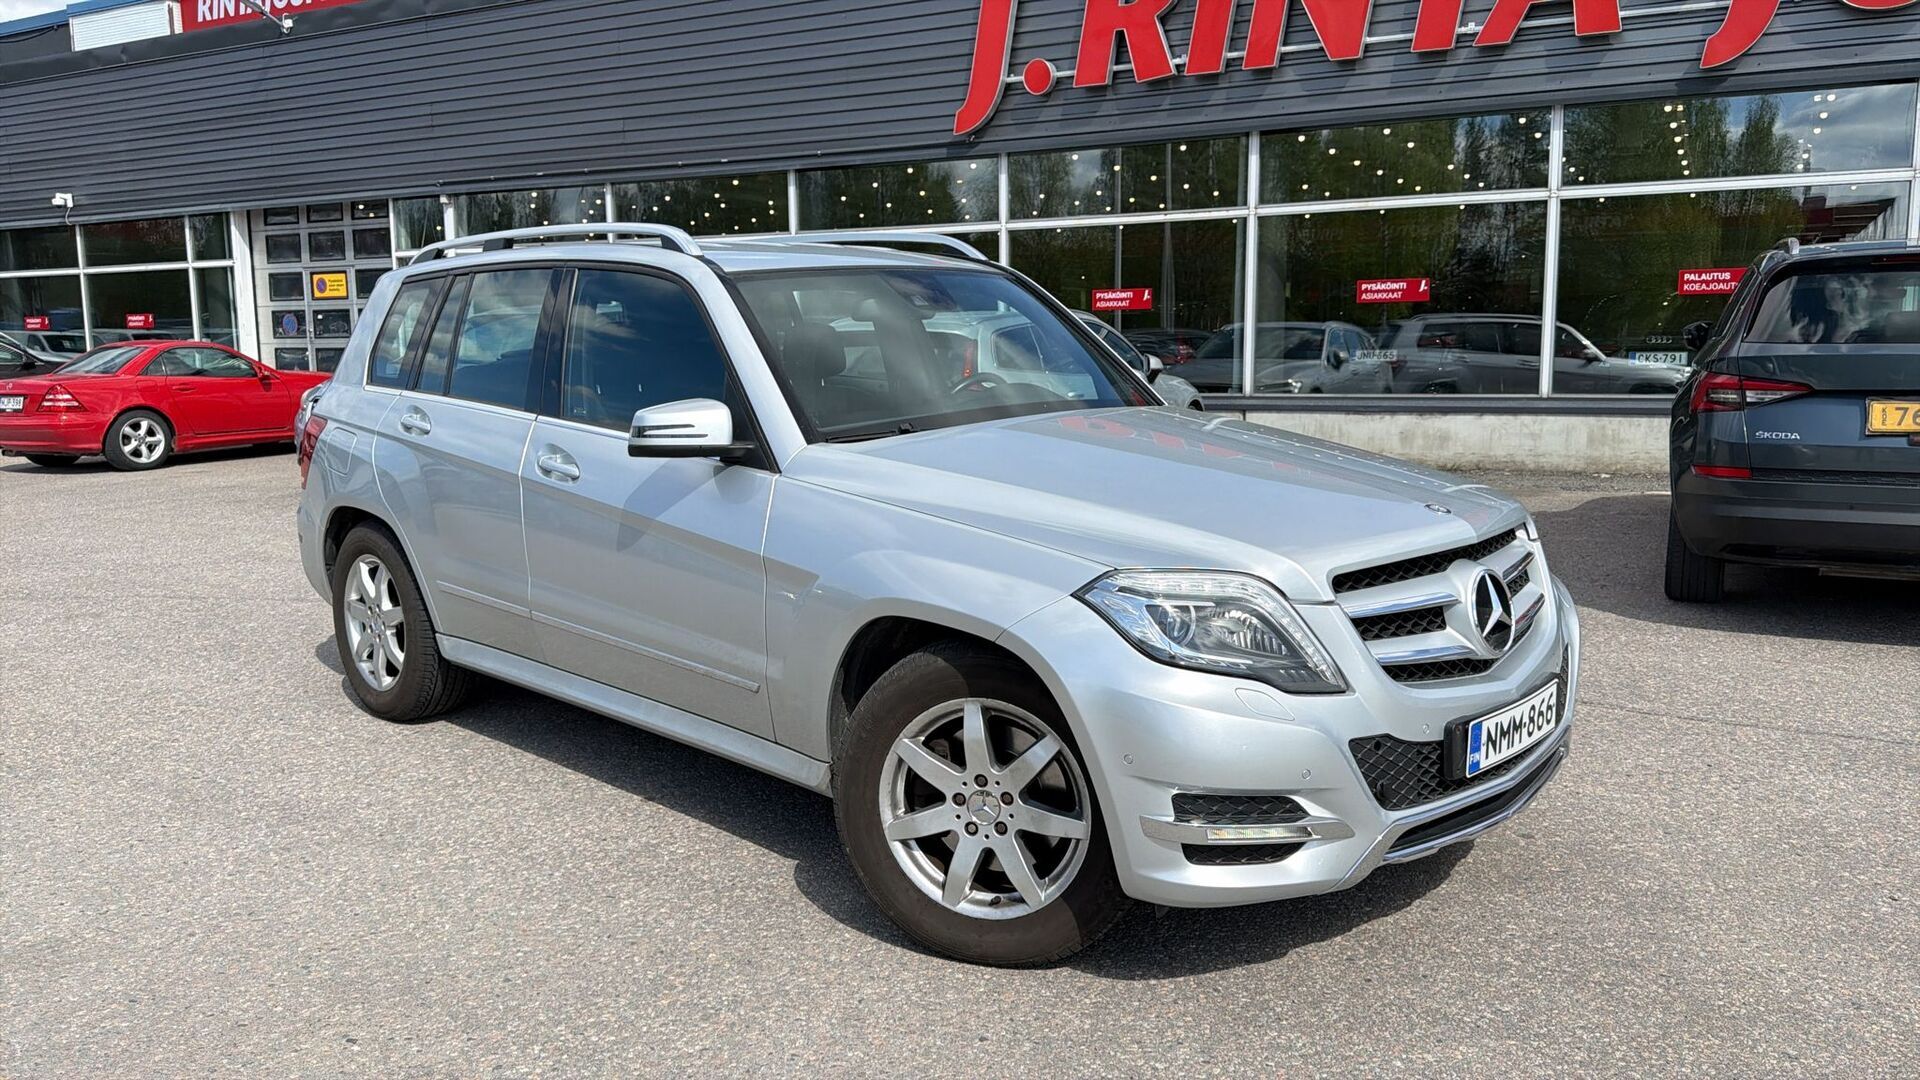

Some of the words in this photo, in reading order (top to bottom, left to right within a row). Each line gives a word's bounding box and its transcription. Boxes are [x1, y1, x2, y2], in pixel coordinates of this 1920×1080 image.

[1683, 272, 1731, 281] PALAUTUS
[1361, 282, 1407, 291] PYSÄKÖINTI
[1683, 282, 1738, 291] KOEAJOAUT
[1361, 291, 1403, 300] ASIAKKAAT
[1637, 353, 1683, 363] CKS-791
[1485, 691, 1555, 761] NMM-866
